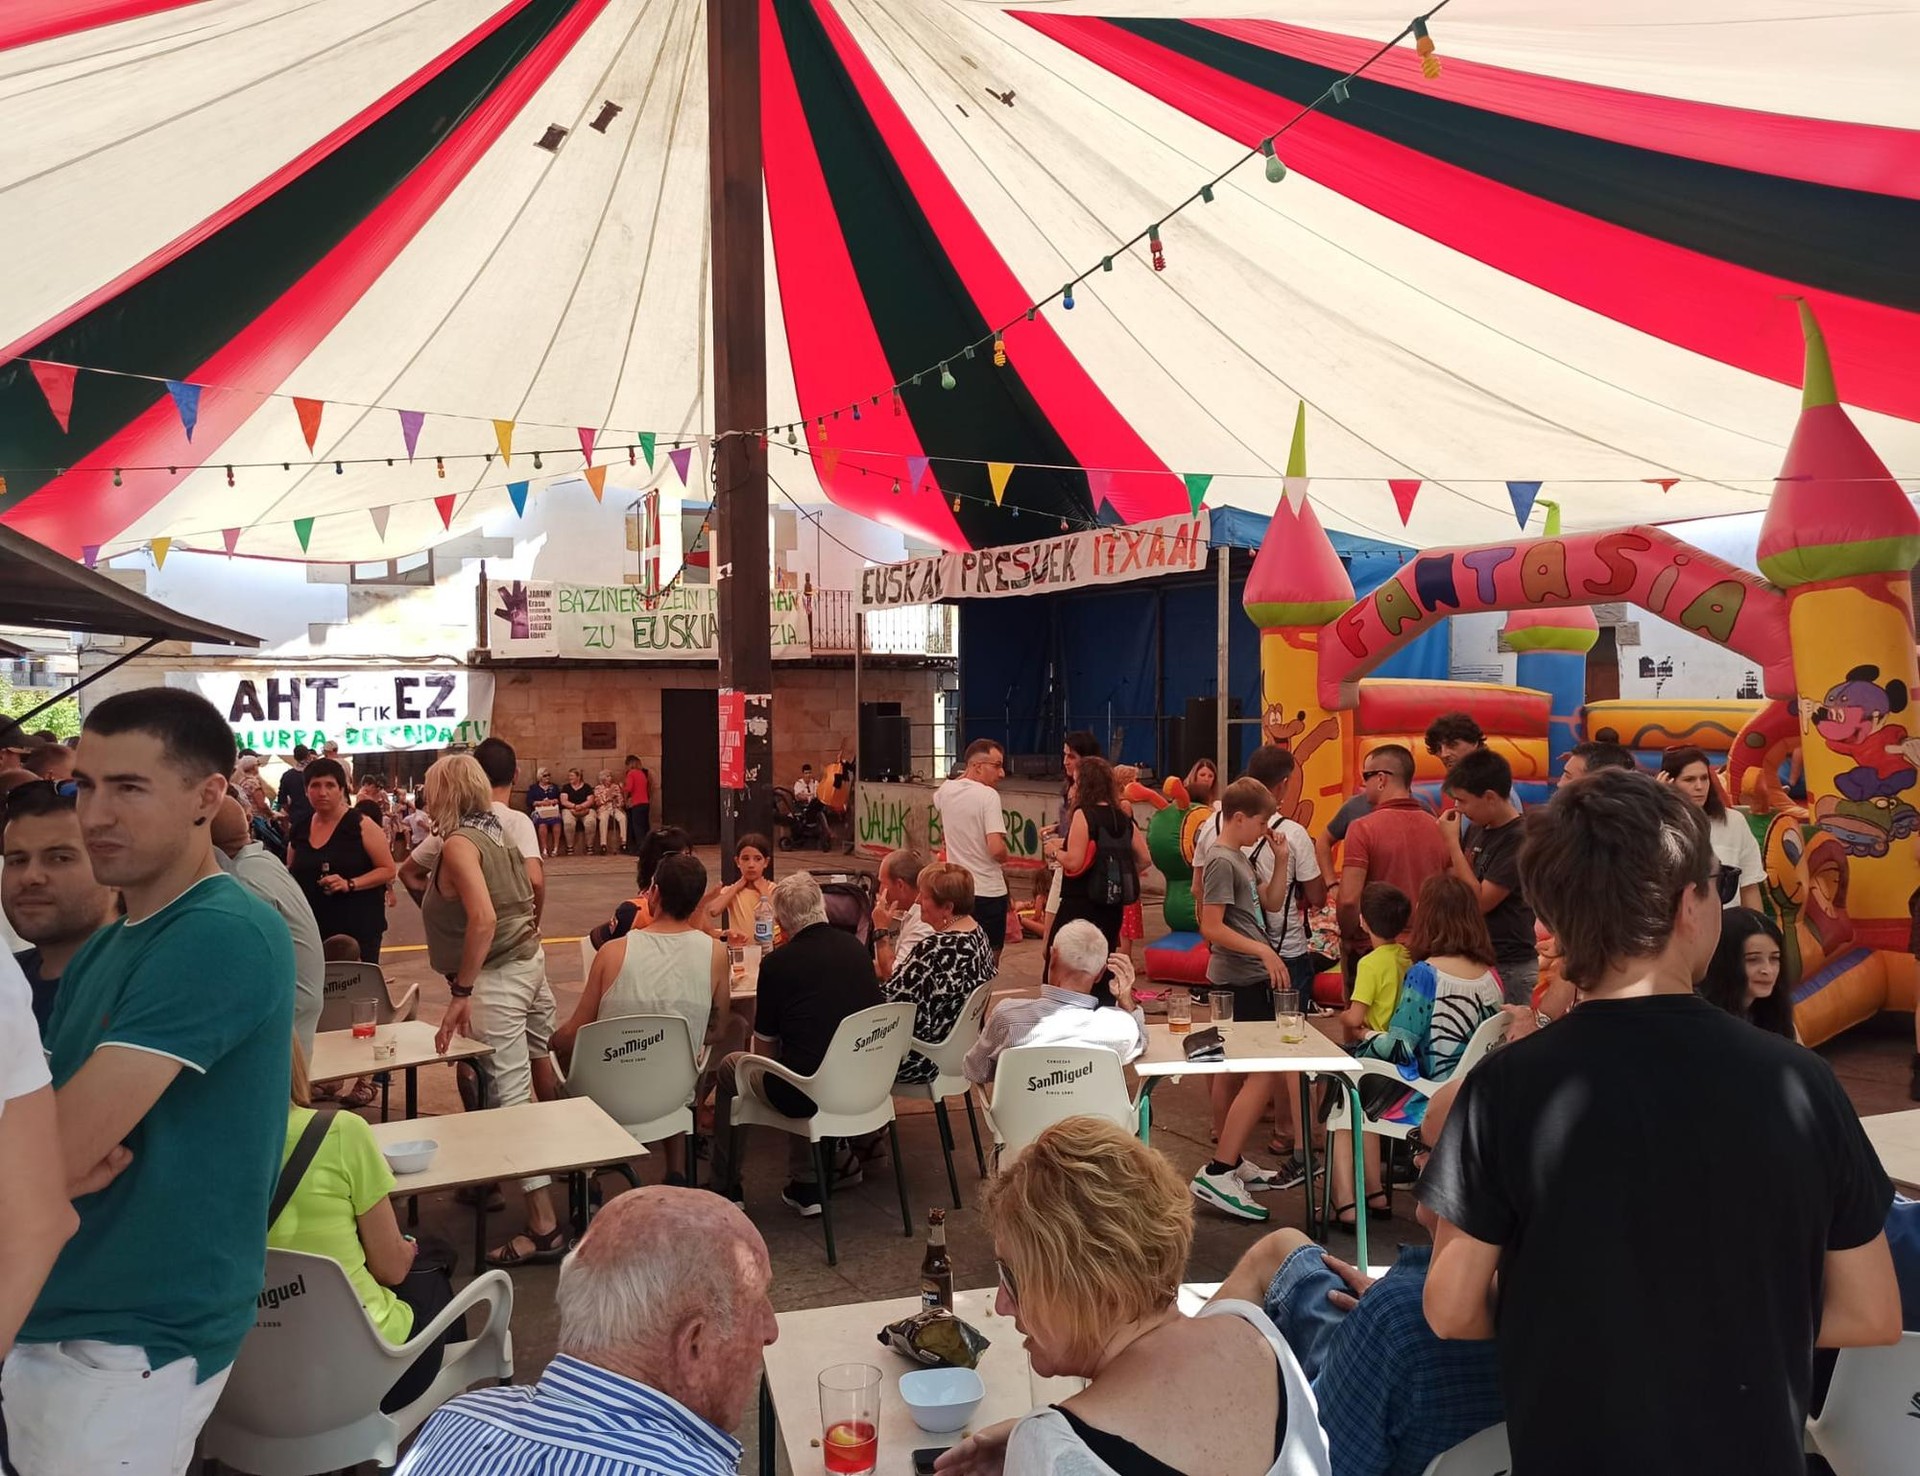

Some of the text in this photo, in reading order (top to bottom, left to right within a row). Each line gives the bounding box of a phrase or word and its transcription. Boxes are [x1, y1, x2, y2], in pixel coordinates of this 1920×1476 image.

[861, 557, 944, 605] EUSKAL
[1093, 520, 1201, 577] ITXAA!
[583, 625, 615, 649] ZU
[632, 613, 720, 649] EUSKIA
[394, 675, 456, 719] EZ
[602, 1029, 664, 1061] SanMiguel
[1027, 1061, 1093, 1091] SanMiguel
[257, 1274, 306, 1309] iguel
